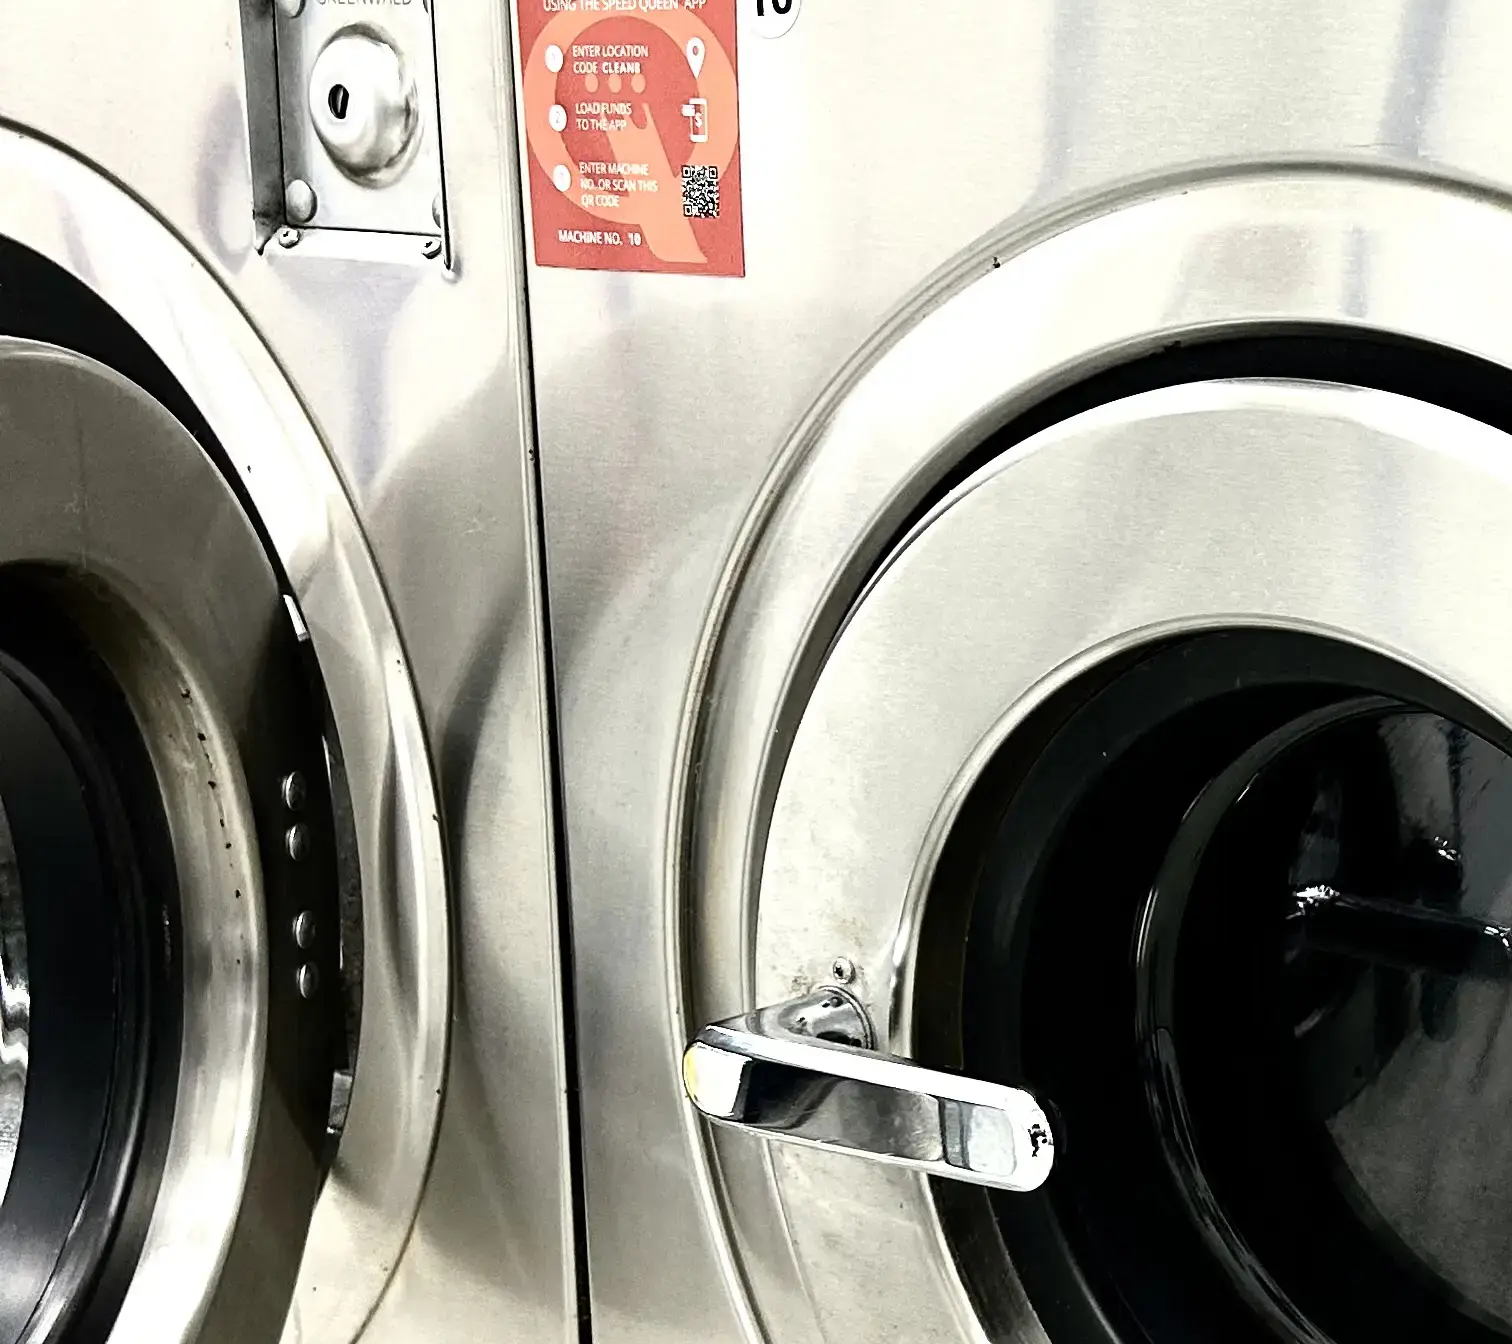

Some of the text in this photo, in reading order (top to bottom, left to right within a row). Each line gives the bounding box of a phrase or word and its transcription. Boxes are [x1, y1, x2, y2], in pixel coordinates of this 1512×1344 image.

[572, 45, 600, 58] ENTER
[602, 45, 649, 58] LOCATION
[573, 61, 598, 74] CODE
[575, 102, 632, 115] LOAD FUNDS
[576, 119, 627, 131] TO THE APP
[579, 162, 649, 176] ENTER MACHINE
[598, 179, 611, 191] OR
[612, 179, 636, 191] SCAN
[638, 179, 658, 192] THIS
[595, 195, 620, 207] CODE
[558, 229, 602, 244] MACHINE
